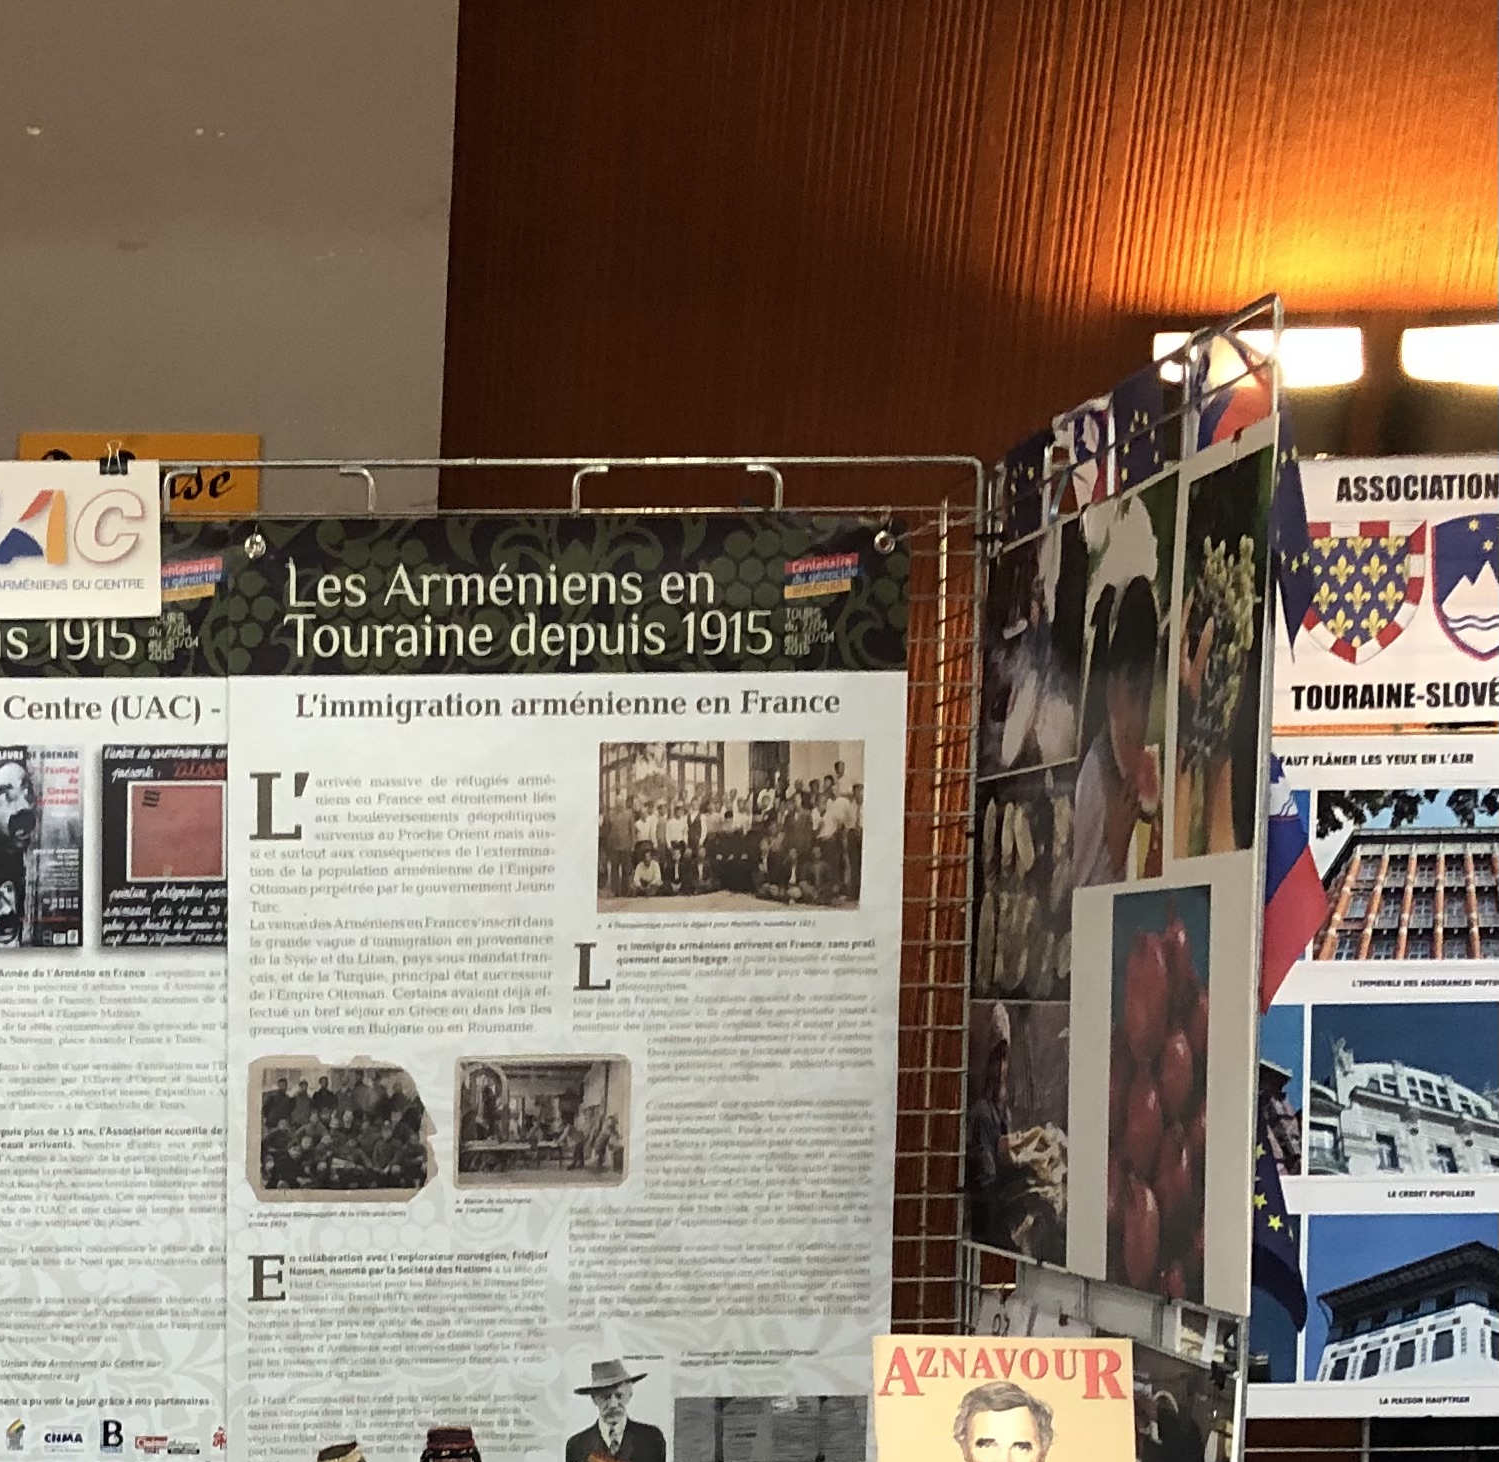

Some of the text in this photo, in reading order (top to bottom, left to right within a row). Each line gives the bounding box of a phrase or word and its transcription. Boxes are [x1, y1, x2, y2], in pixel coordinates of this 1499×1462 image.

[1336, 473, 1499, 502] ASSOCIATION
[71, 578, 91, 590] DU
[93, 577, 145, 590] CENTRE
[288, 561, 714, 607] Les Arméniens en
[46, 617, 138, 661] 1915
[283, 609, 773, 666] Touraine depuis 1915
[3, 695, 101, 720] Centre
[110, 695, 201, 725] (UAC)
[296, 689, 840, 724] L'immigration arménienne en France
[1311, 752, 1357, 766] FLÂNER
[1360, 753, 1382, 765] LES
[1385, 753, 1417, 765] YEUX
[1420, 753, 1437, 765] EN
[1439, 752, 1474, 764] L'AIR
[878, 1346, 1127, 1400] AZNAVOUR
